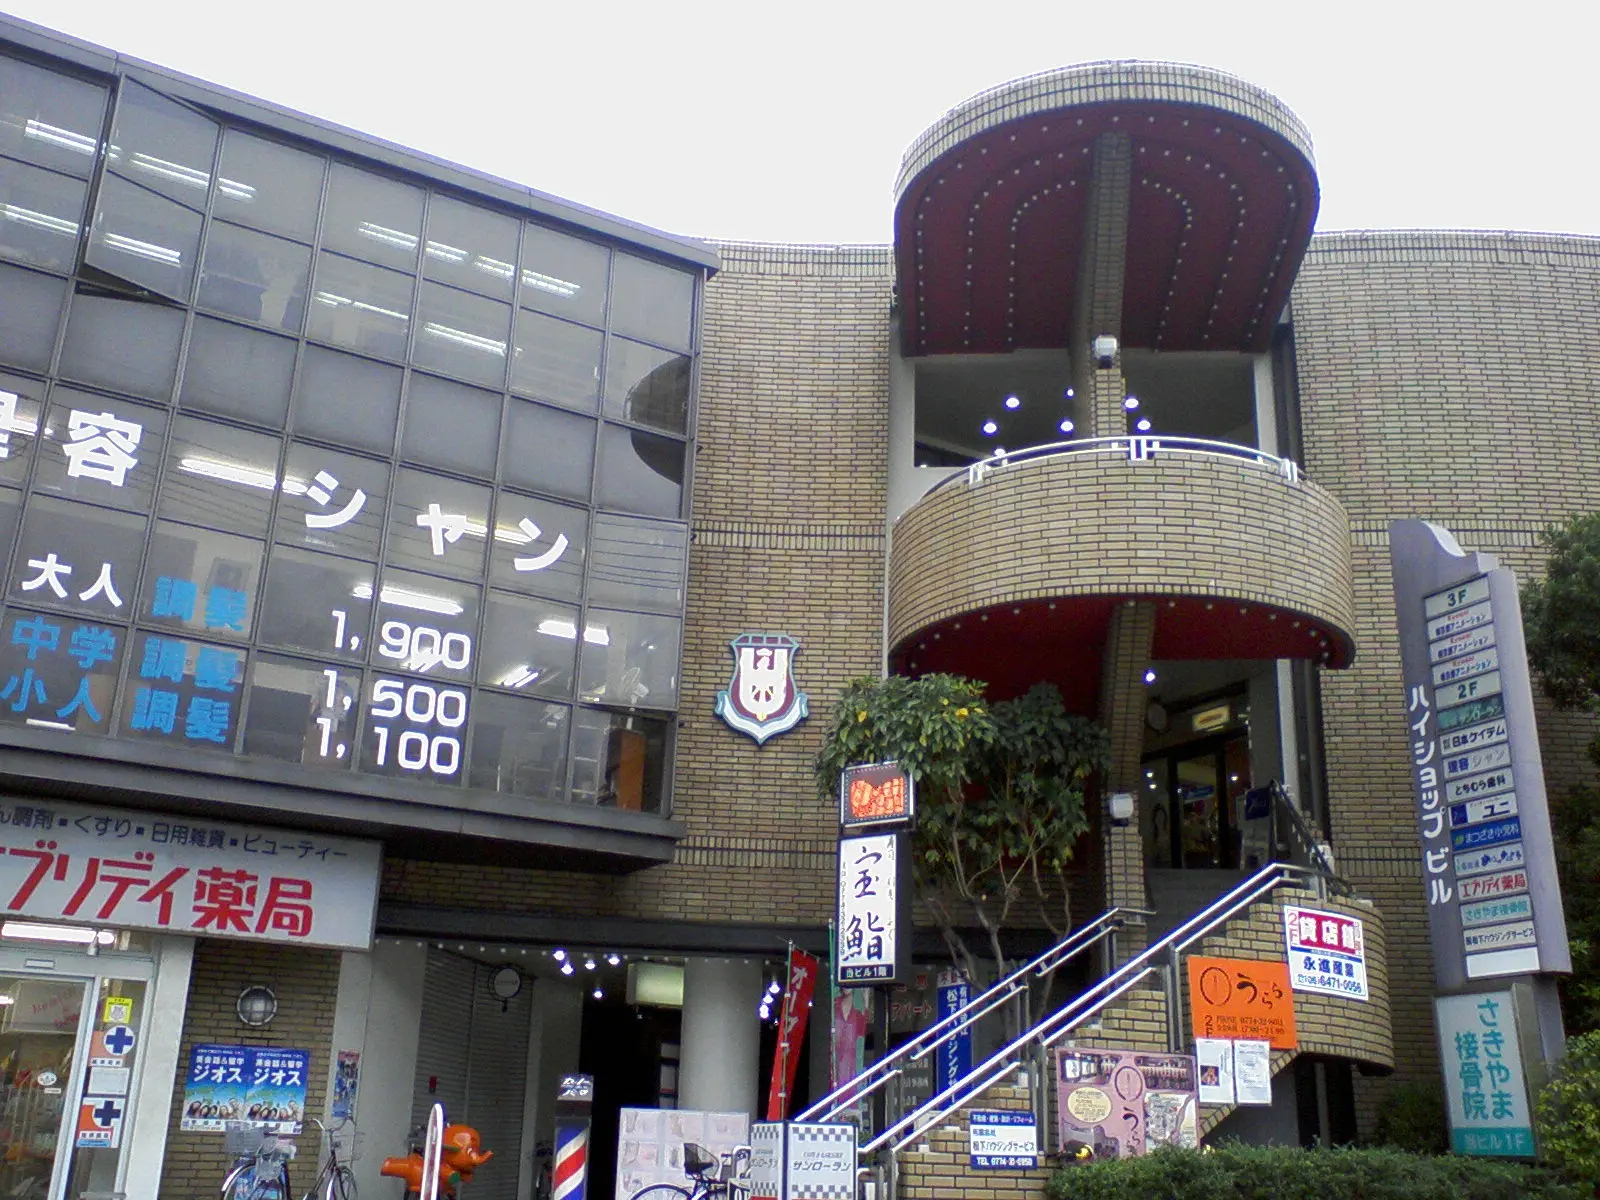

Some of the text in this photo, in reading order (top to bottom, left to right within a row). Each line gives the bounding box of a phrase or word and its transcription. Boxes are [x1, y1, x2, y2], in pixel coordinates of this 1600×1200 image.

[22, 553, 123, 608] 大人
[331, 609, 472, 671] 1,900
[1447, 588, 1467, 607] 3F
[10, 615, 117, 669] 中学
[323, 668, 467, 729] 1,500
[1458, 681, 1478, 699] 2F
[1, 668, 101, 723] 小人
[316, 717, 461, 775] 1,100
[1410, 684, 1452, 905] ハイショップビル
[193, 1064, 242, 1083] ジオス
[254, 1067, 301, 1086] ジオス
[1454, 1031, 1489, 1120] 接骨院
[1477, 998, 1514, 1120] さきやま
[792, 1160, 851, 1172] サンローラン
